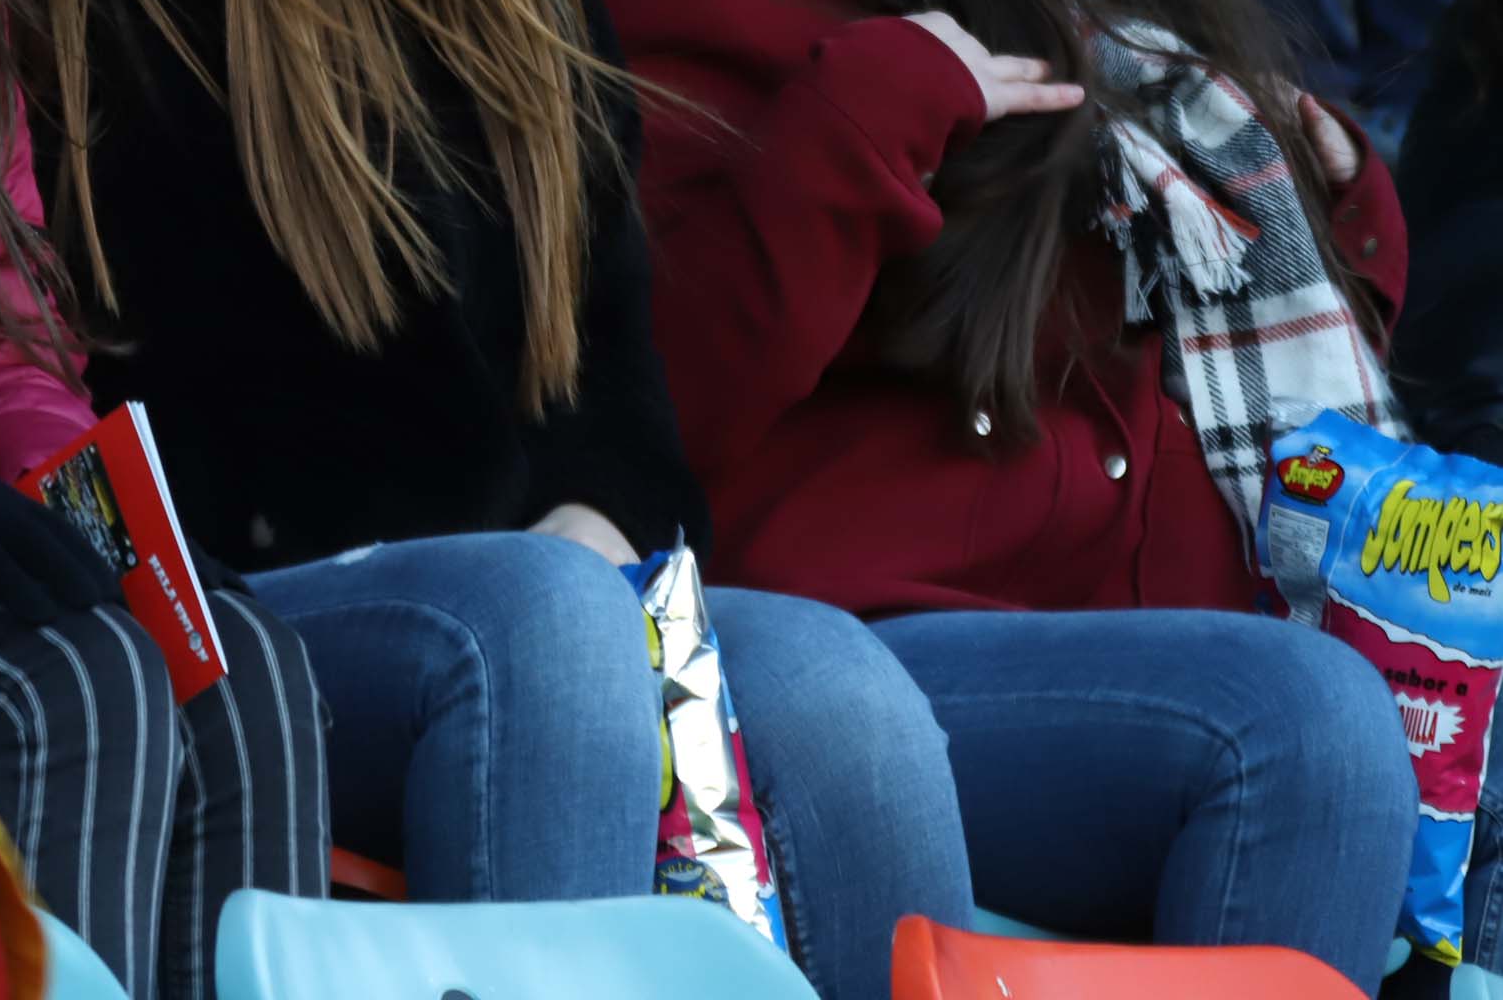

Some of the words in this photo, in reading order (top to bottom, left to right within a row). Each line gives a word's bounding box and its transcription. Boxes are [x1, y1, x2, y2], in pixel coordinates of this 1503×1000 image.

[1361, 479, 1503, 604] Jumpers
[1454, 682, 1469, 697] a
[1399, 704, 1438, 746] UILLA
